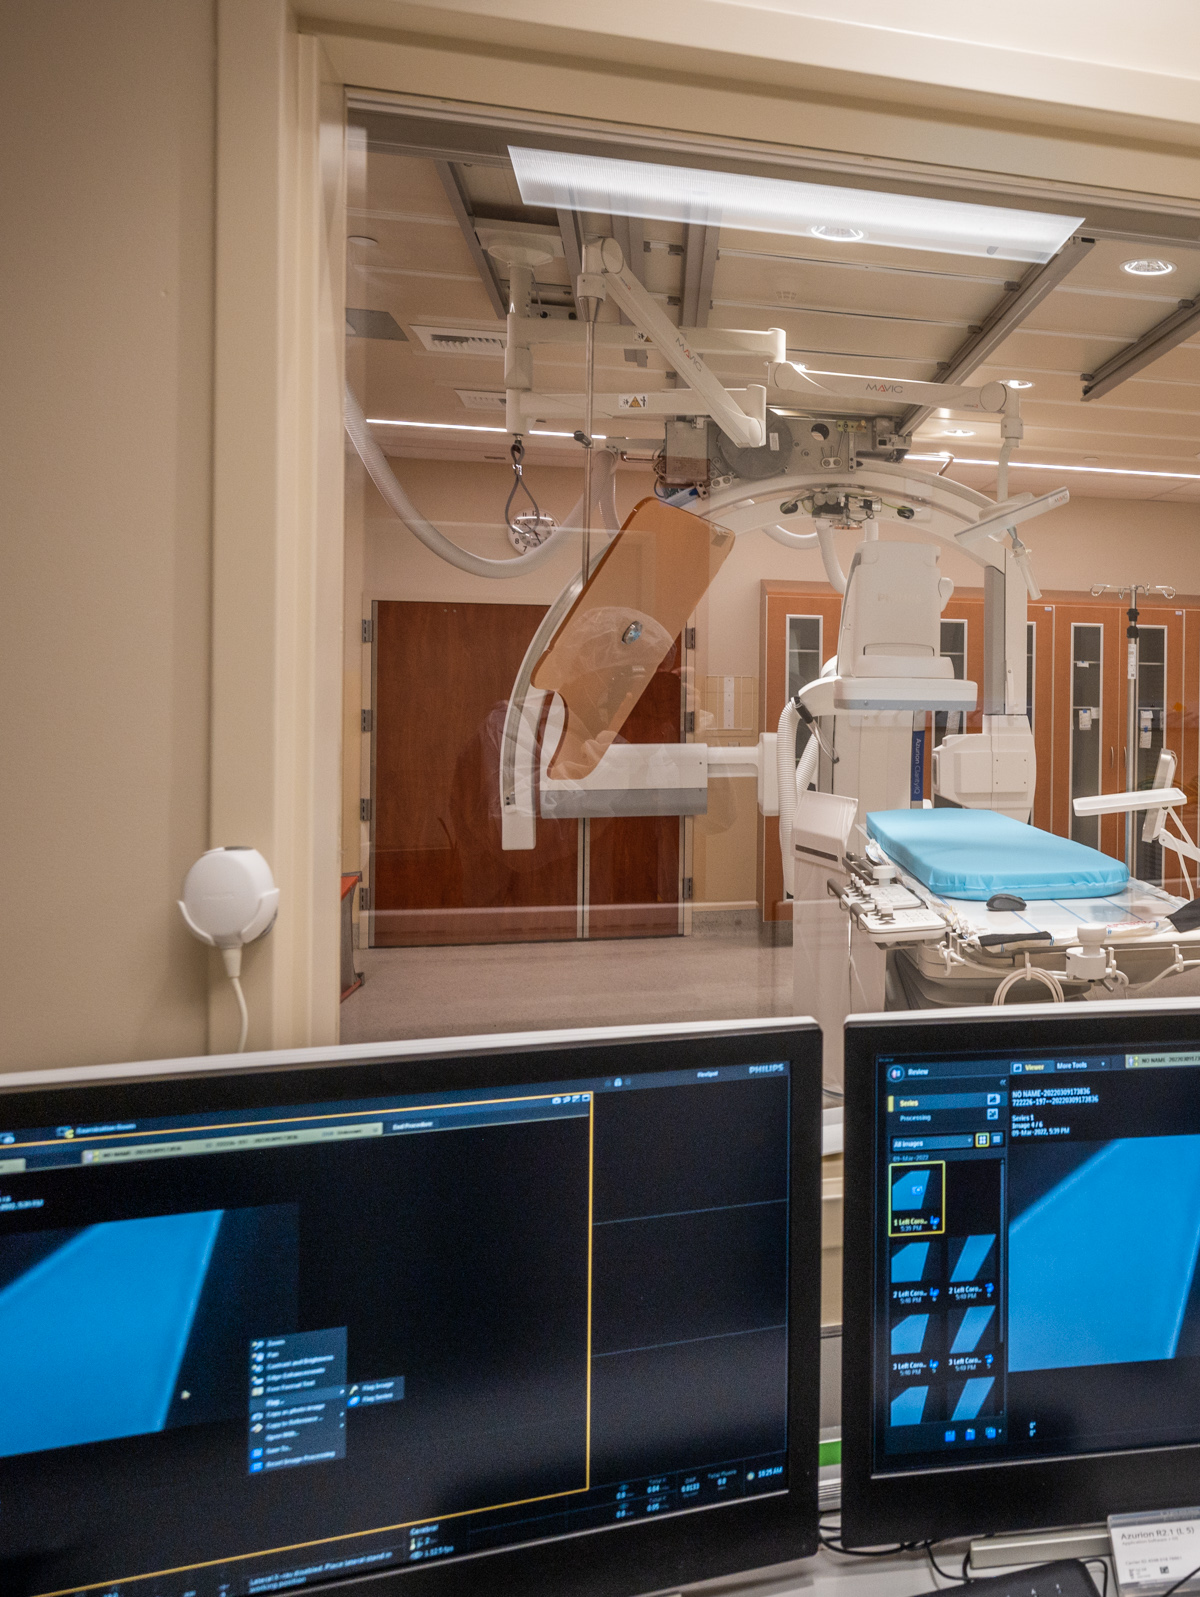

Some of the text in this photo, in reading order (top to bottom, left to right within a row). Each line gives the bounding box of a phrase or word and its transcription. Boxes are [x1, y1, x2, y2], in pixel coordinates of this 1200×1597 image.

[676, 337, 702, 372] MAVIC
[866, 383, 903, 394] MAVIC
[749, 1064, 784, 1074] PHILIPS
[1024, 1063, 1045, 1072] Viewer
[1056, 1060, 1088, 1070] More Tools
[908, 1067, 929, 1076] Review
[1012, 1090, 1022, 1098] NO
[900, 1098, 919, 1108] Series
[900, 1114, 932, 1123] Processing
[1060, 1126, 1070, 1134] PM
[902, 1140, 924, 1148] Images
[773, 1466, 783, 1474] AM
[1121, 1531, 1154, 1540] Azurion
[1156, 1529, 1174, 1537] R2.1
